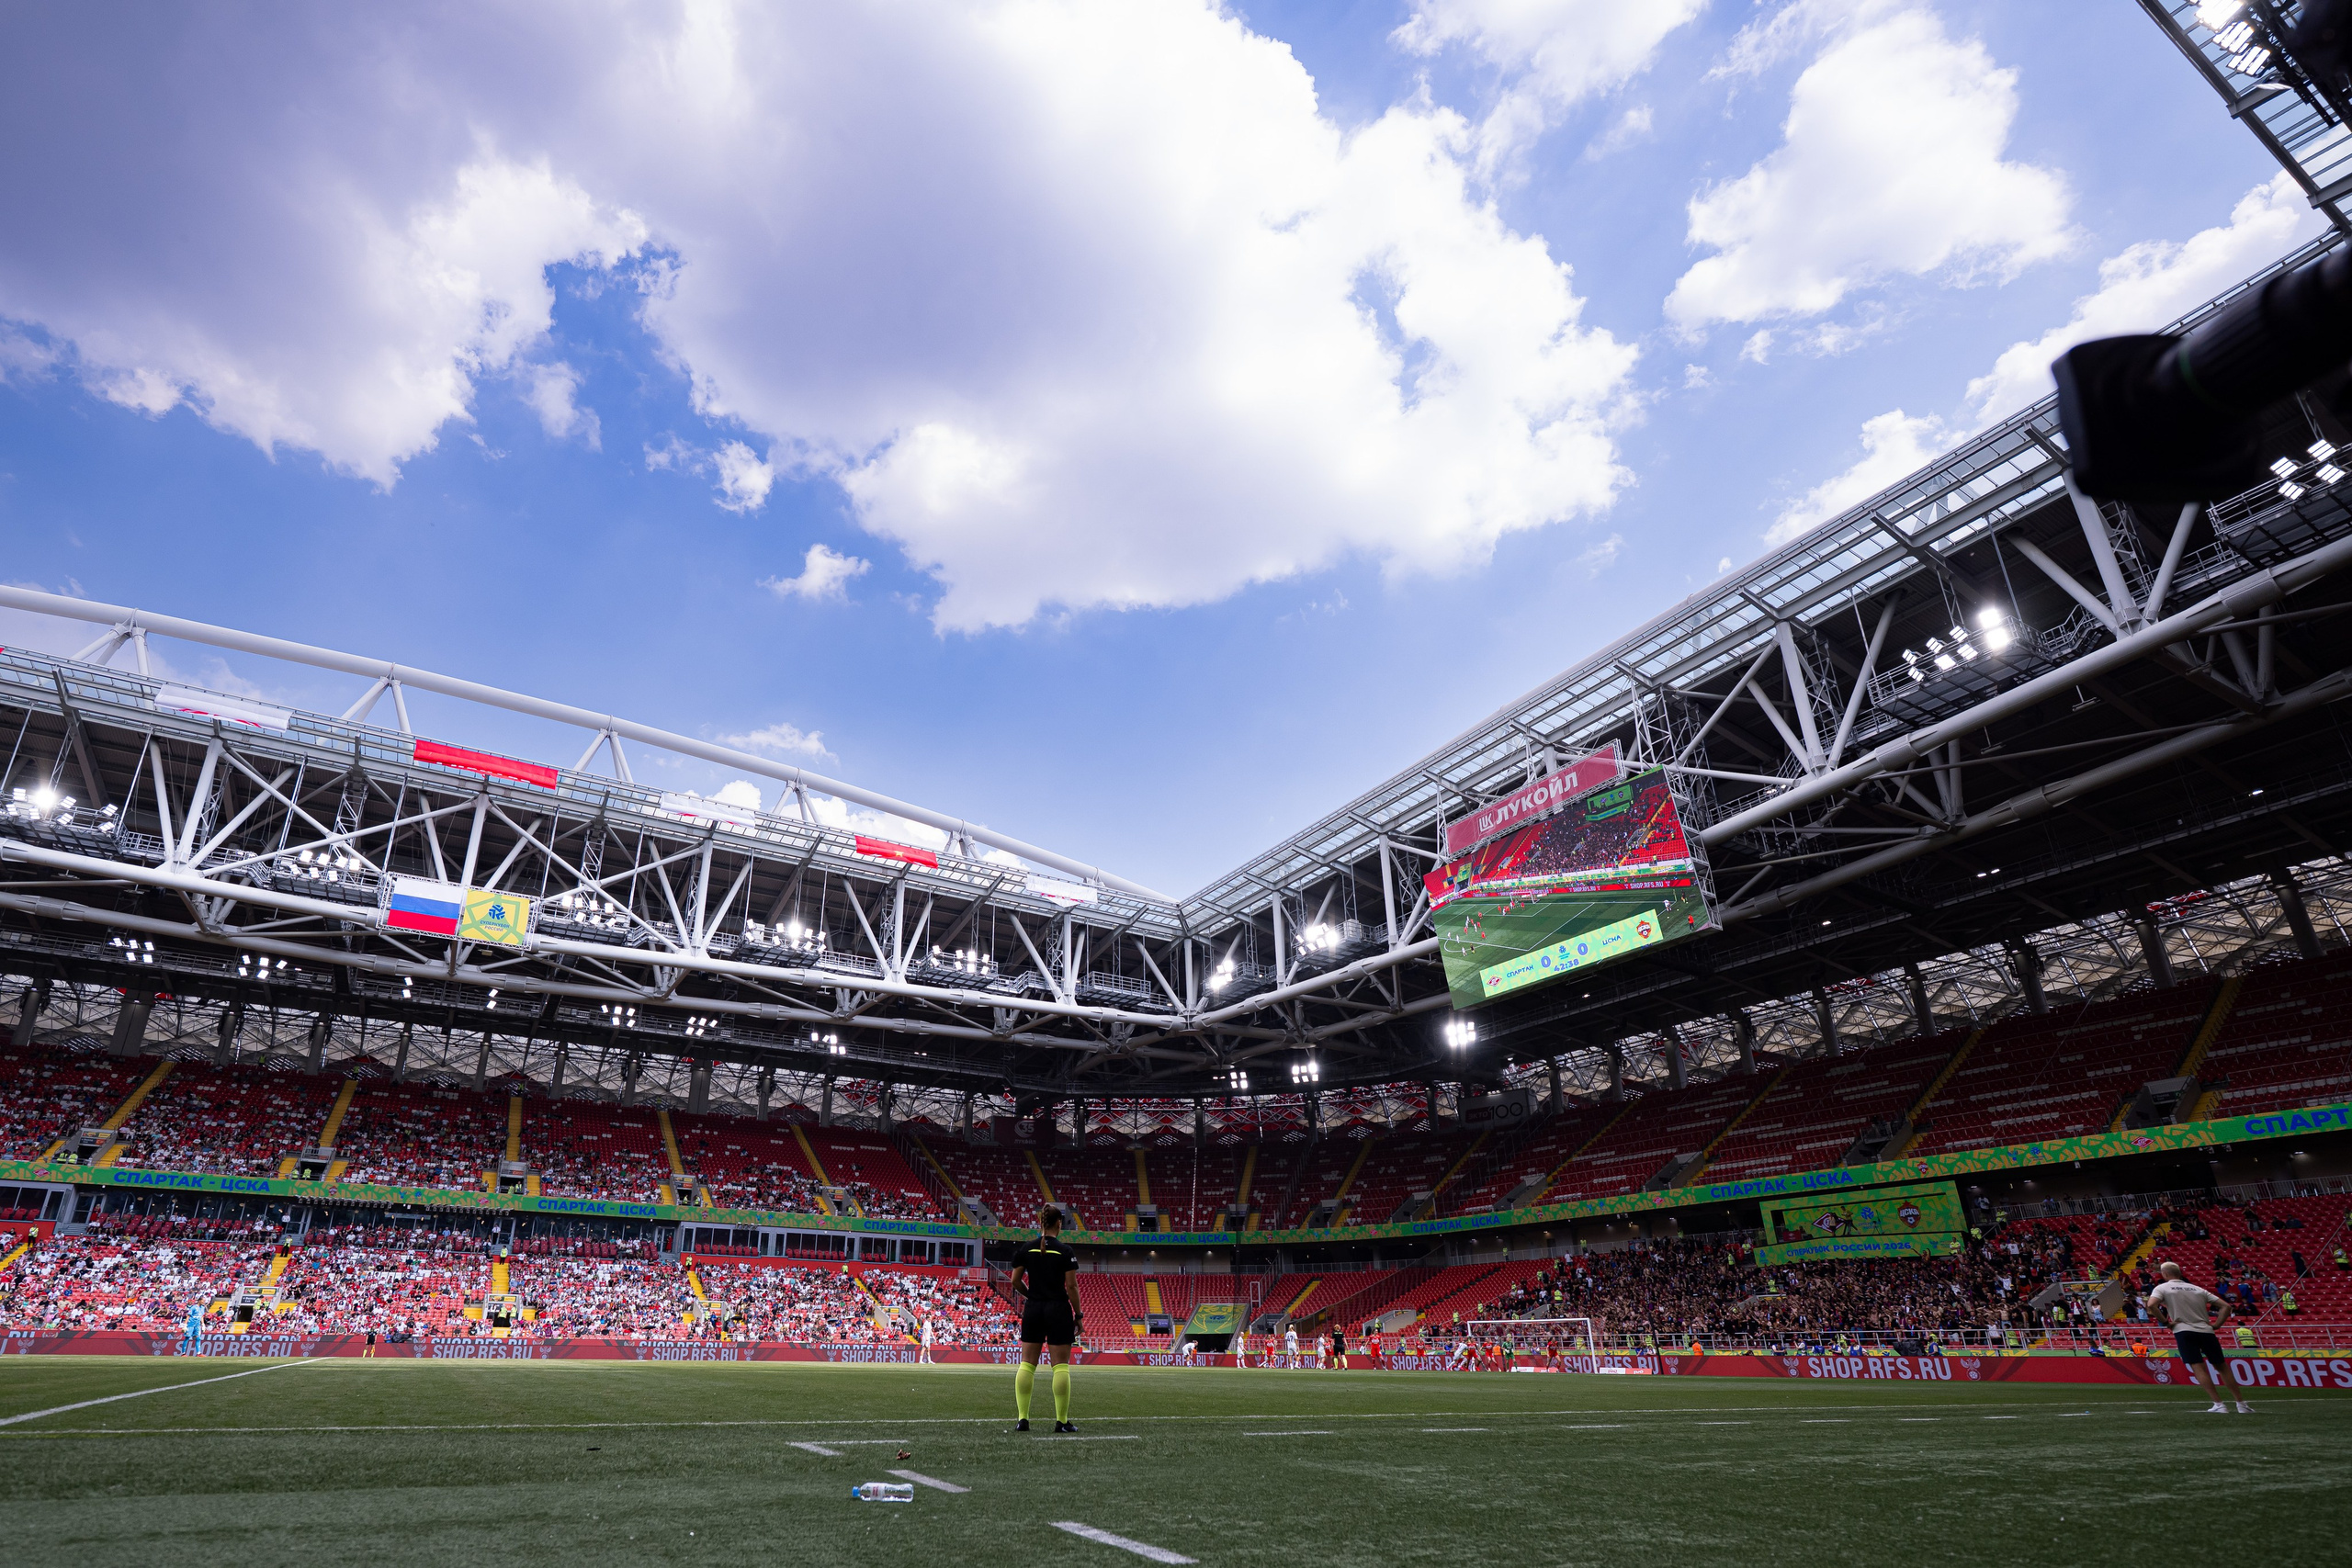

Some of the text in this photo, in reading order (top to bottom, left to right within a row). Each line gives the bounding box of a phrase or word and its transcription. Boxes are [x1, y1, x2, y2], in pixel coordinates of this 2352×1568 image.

[1496, 772, 1578, 825] ЛУКОЙЛ
[480, 919, 510, 929] СУПЕРКУБОК
[1602, 934, 1622, 946] ЦСКА
[1577, 942, 1589, 955] 0
[1541, 955, 1551, 968] 0
[1554, 958, 1579, 972] 42:38
[1507, 964, 1534, 978] СПАРТАК
[1488, 1102, 1523, 1120] 100
[2245, 1108, 2349, 1135] СПАРТ
[114, 1171, 203, 1189] СПАРТАК
[220, 1178, 271, 1192] ЦСКА
[1710, 1179, 1787, 1199] СПАРТАК
[1802, 1170, 1854, 1190] ЦСКА
[537, 1199, 606, 1213] СПАРТАК
[619, 1205, 657, 1218] ЦСКА
[864, 1220, 918, 1233] СПАРТАК
[928, 1225, 958, 1236] ЦСКА
[1412, 1220, 1462, 1234] СПАРТАК
[1471, 1214, 1500, 1228] ЦСКА
[1135, 1234, 1188, 1243] СПАРТАК
[1198, 1234, 1229, 1244] ЦСКА
[1786, 1242, 1911, 1258] СУПЕРКУБОК РОССИИ 2026
[432, 1344, 533, 1359] SHOP.RFS.RU
[652, 1347, 739, 1361] SHOP.RFS.RU
[841, 1349, 916, 1363] SHOP.RFS.RU
[1807, 1357, 1952, 1381] SHOP.RFS.RU
